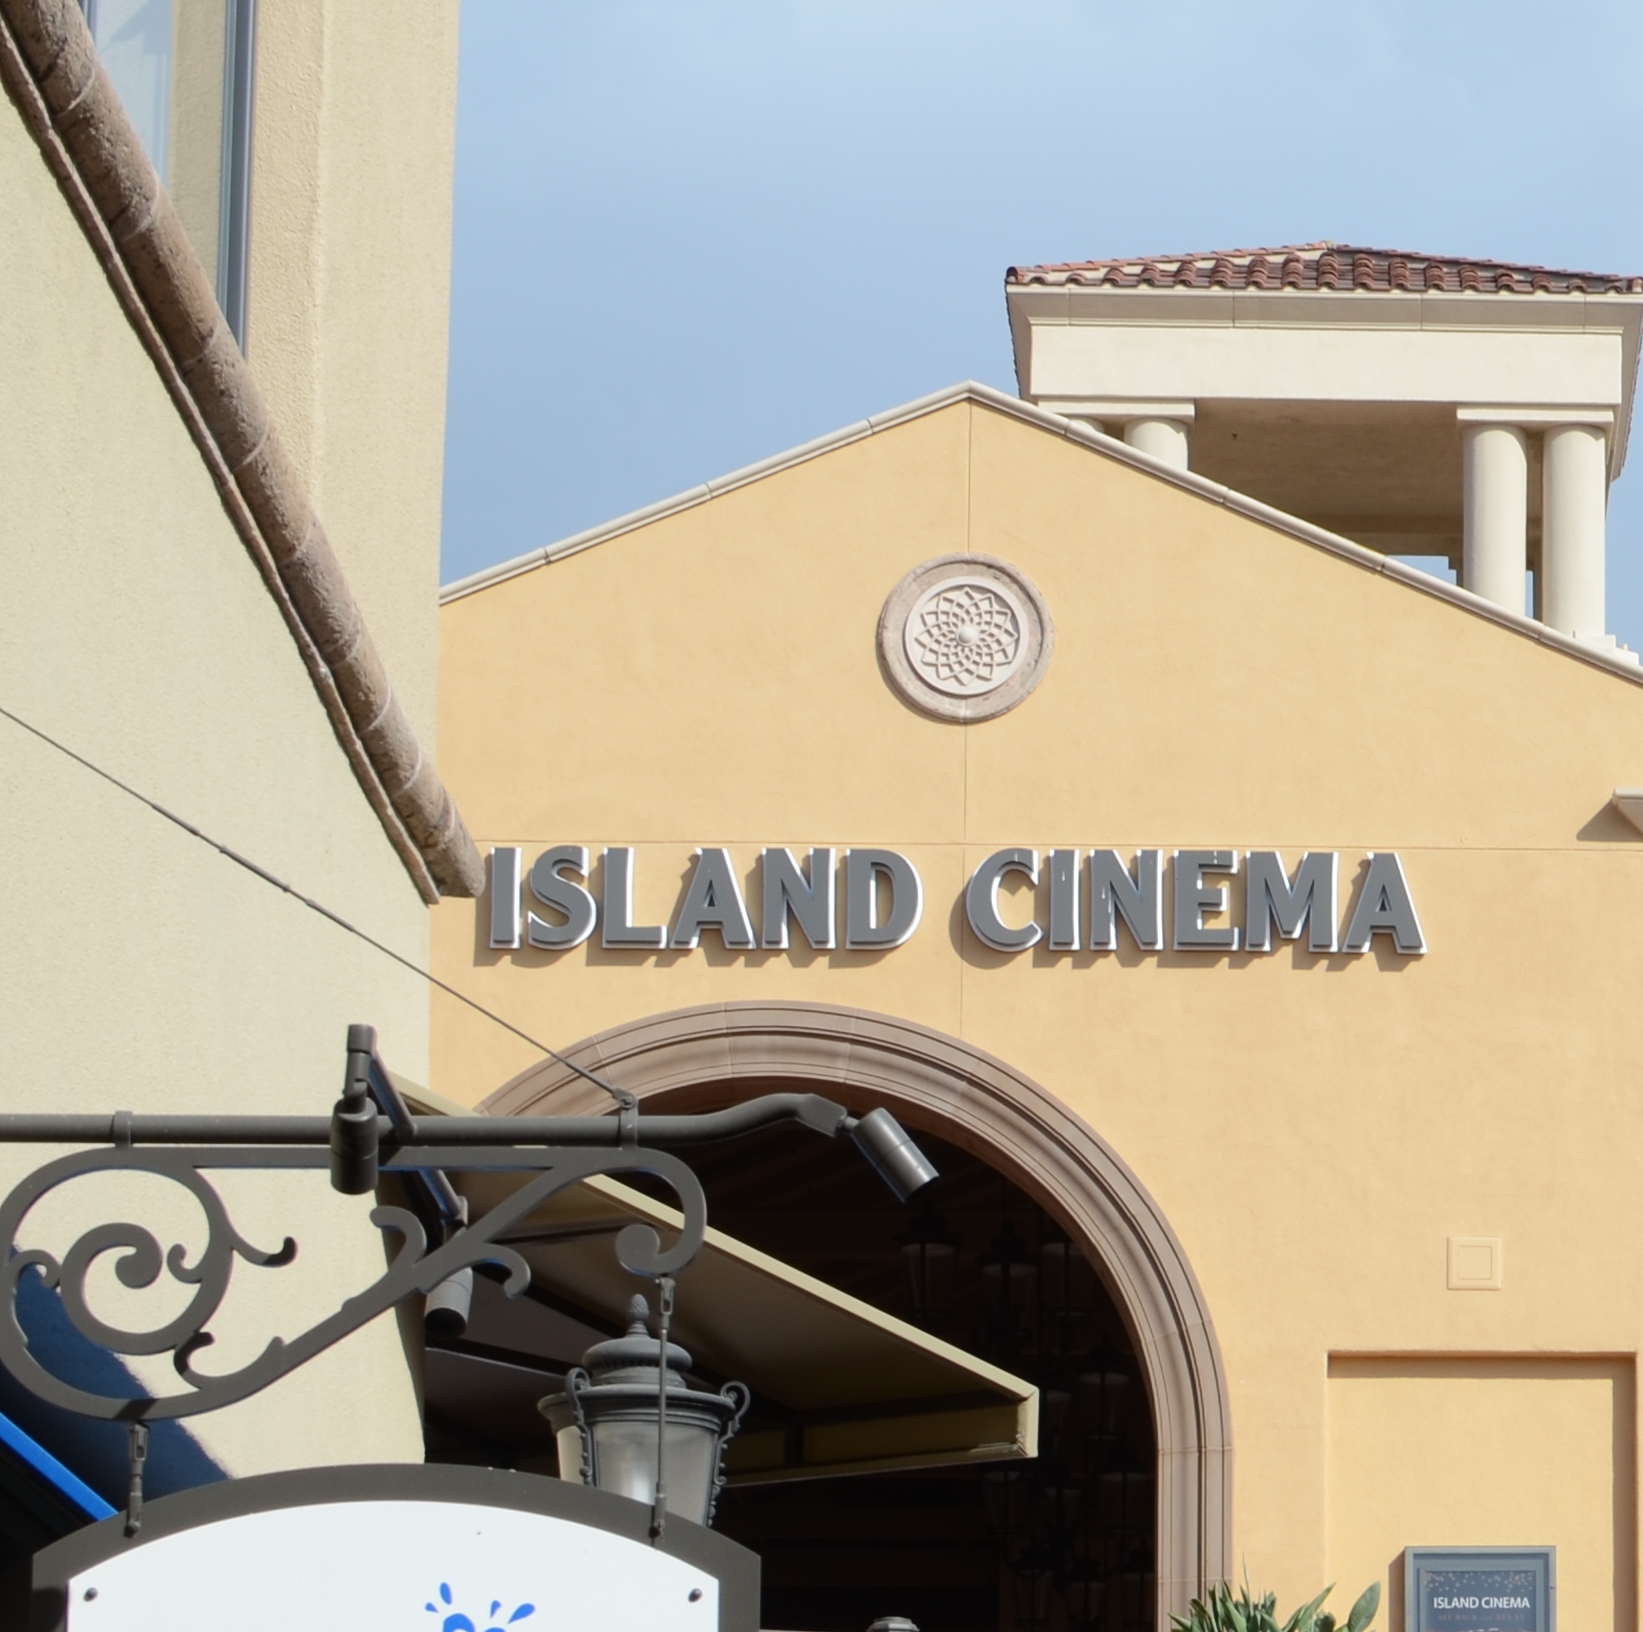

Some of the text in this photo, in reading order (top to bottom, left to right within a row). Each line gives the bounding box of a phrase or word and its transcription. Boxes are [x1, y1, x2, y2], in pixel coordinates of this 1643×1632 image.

[487, 846, 1428, 954] ISLAND CINEMA
[1433, 1596, 1530, 1609] ISLAND CINEMA
